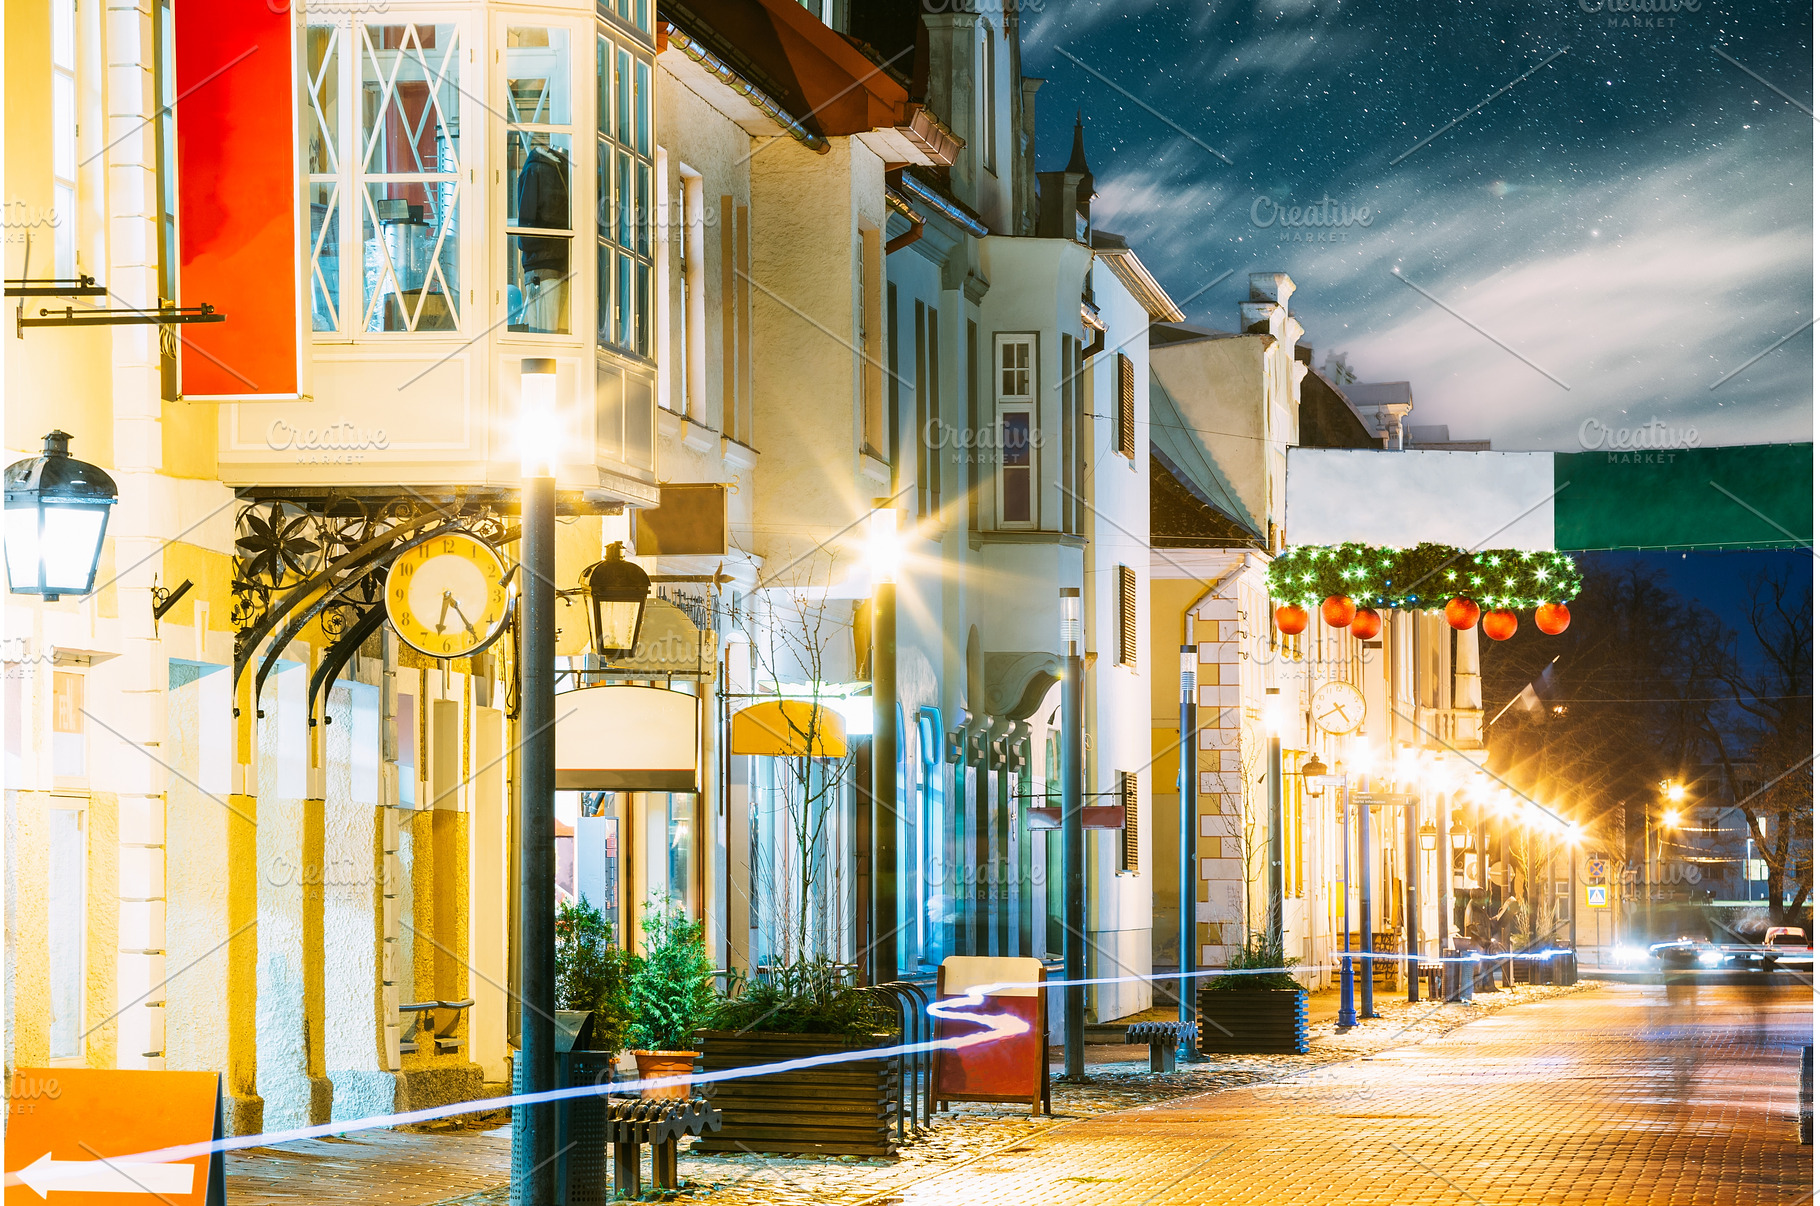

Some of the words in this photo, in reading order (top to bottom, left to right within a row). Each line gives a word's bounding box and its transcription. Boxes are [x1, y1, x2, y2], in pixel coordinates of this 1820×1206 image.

[418, 544, 429, 558] 11
[442, 539, 454, 553] 12
[472, 544, 476, 558] 1
[399, 562, 413, 576] 10
[488, 564, 496, 578] 2
[396, 589, 404, 602] 9
[493, 590, 501, 603] 3
[402, 612, 410, 626] 8
[486, 613, 494, 627] 4
[420, 632, 428, 646] 7
[443, 638, 451, 652] 6
